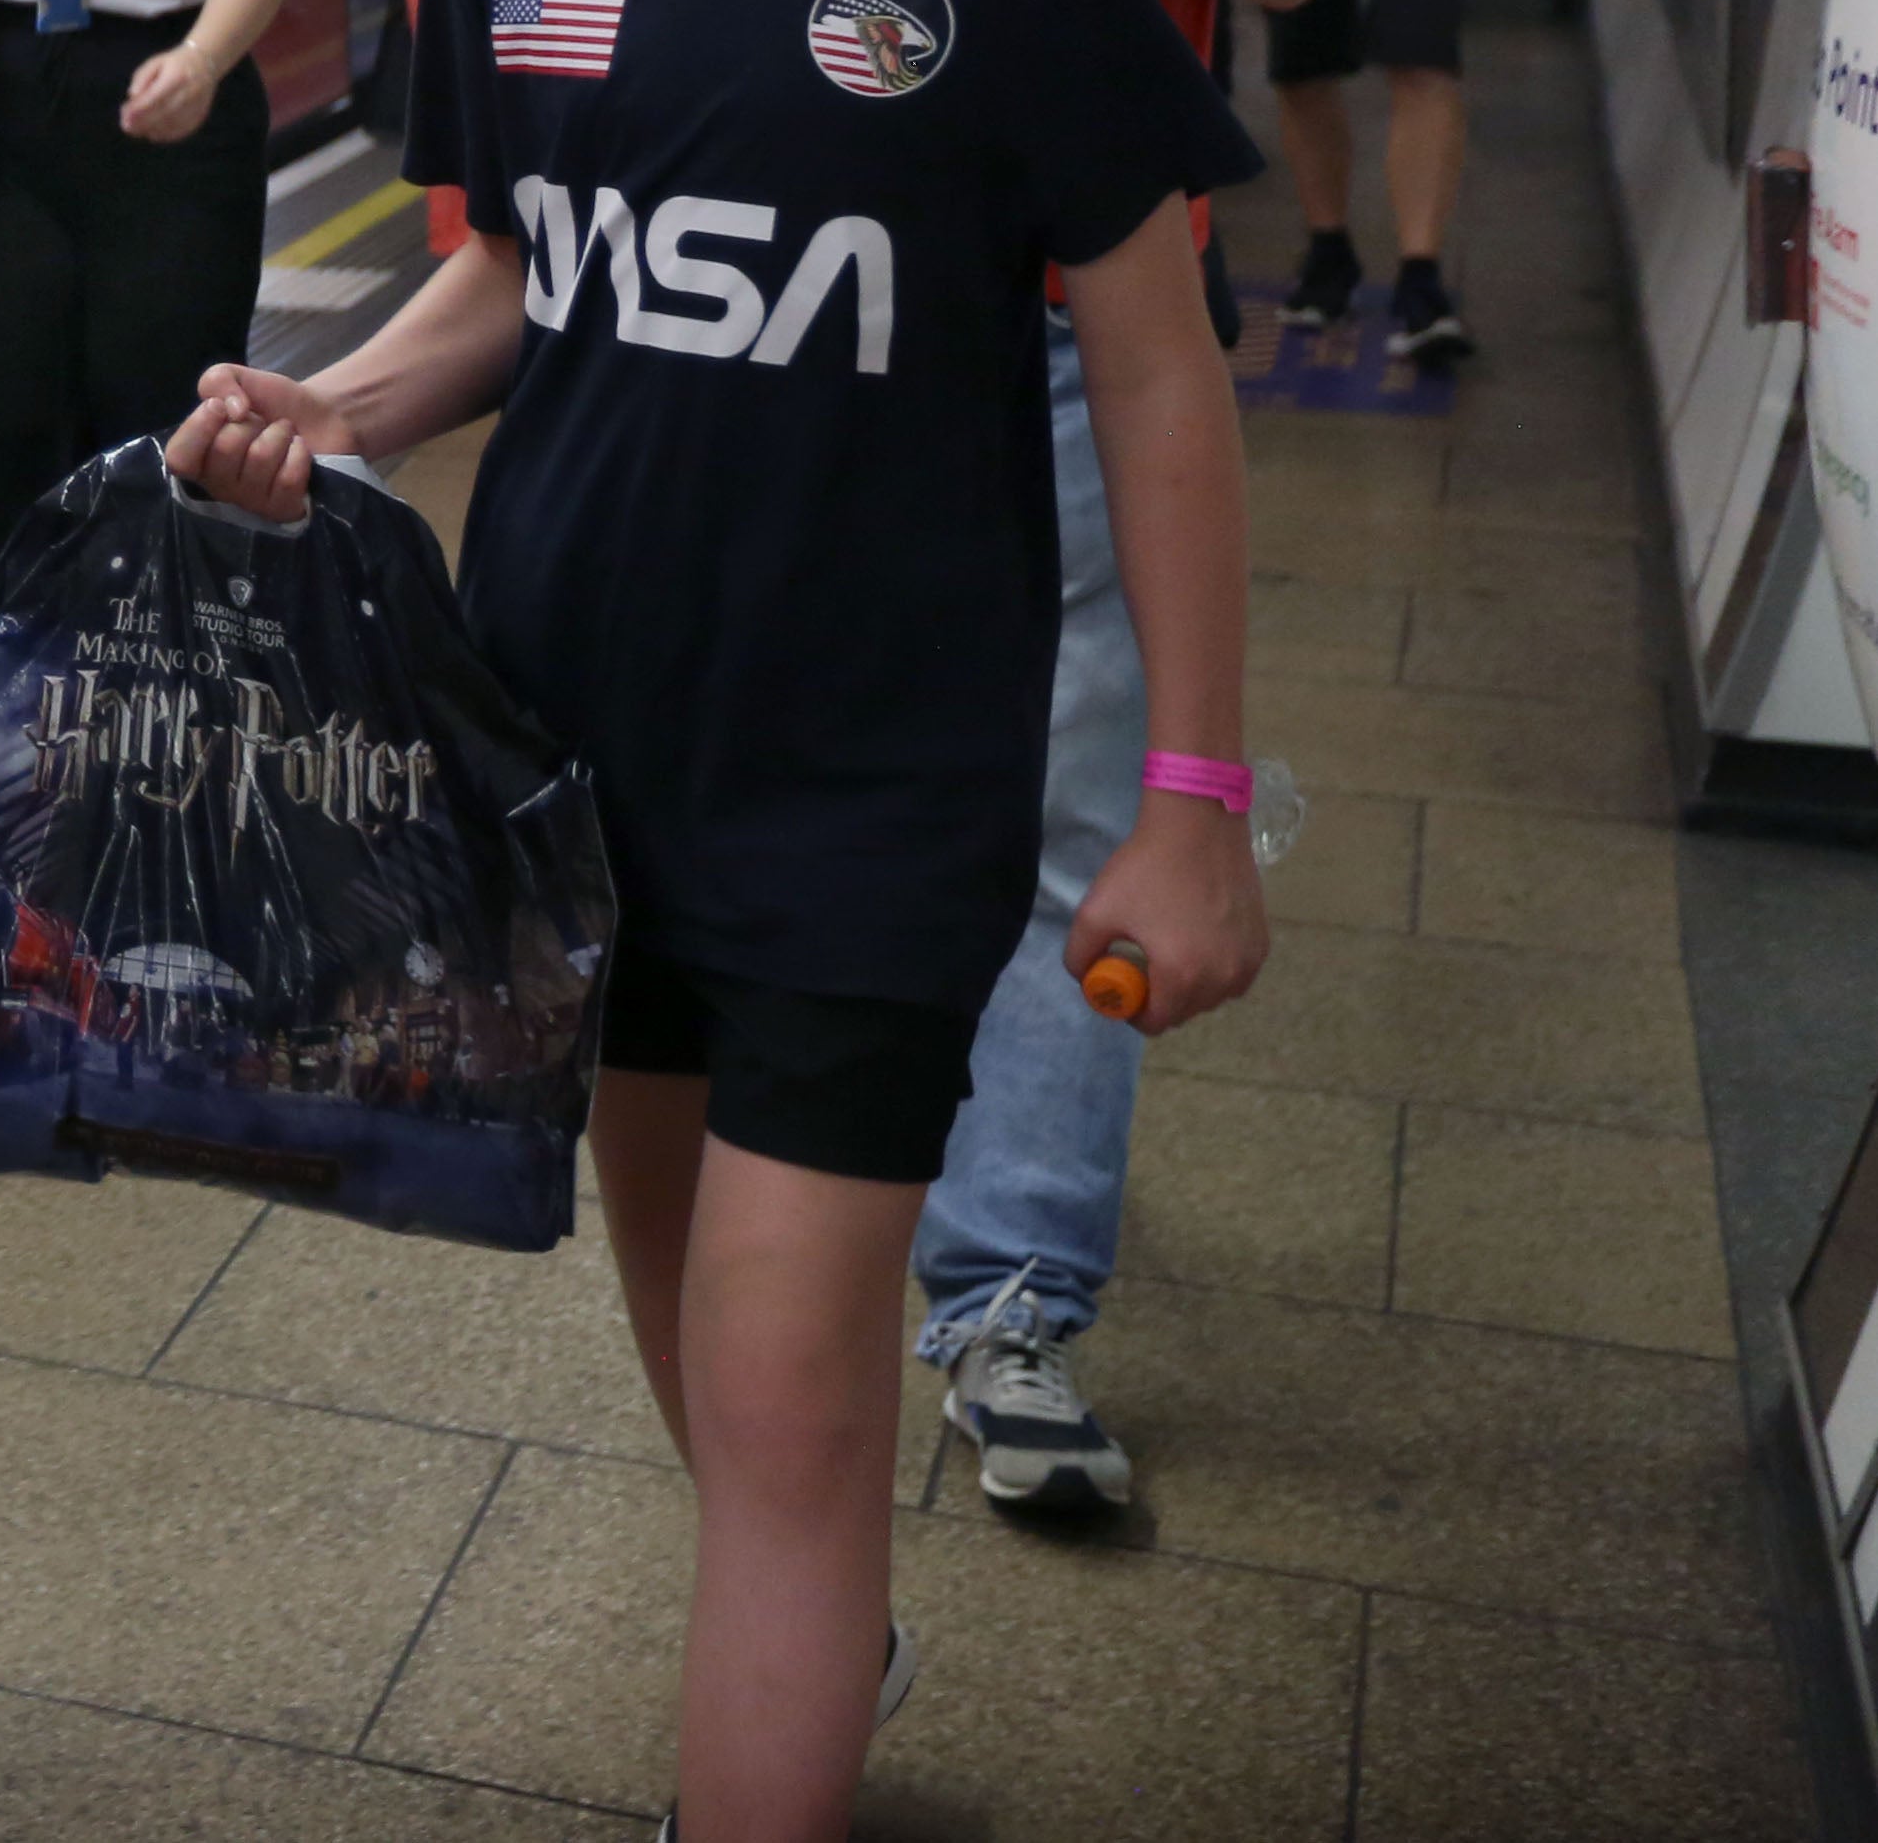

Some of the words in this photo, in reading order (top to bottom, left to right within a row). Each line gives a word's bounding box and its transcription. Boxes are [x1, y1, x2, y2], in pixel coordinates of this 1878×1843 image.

[514, 175, 894, 374] NASA
[193, 614, 244, 637] STUDIO
[245, 629, 285, 647] TOUR
[228, 677, 436, 868] Potter
